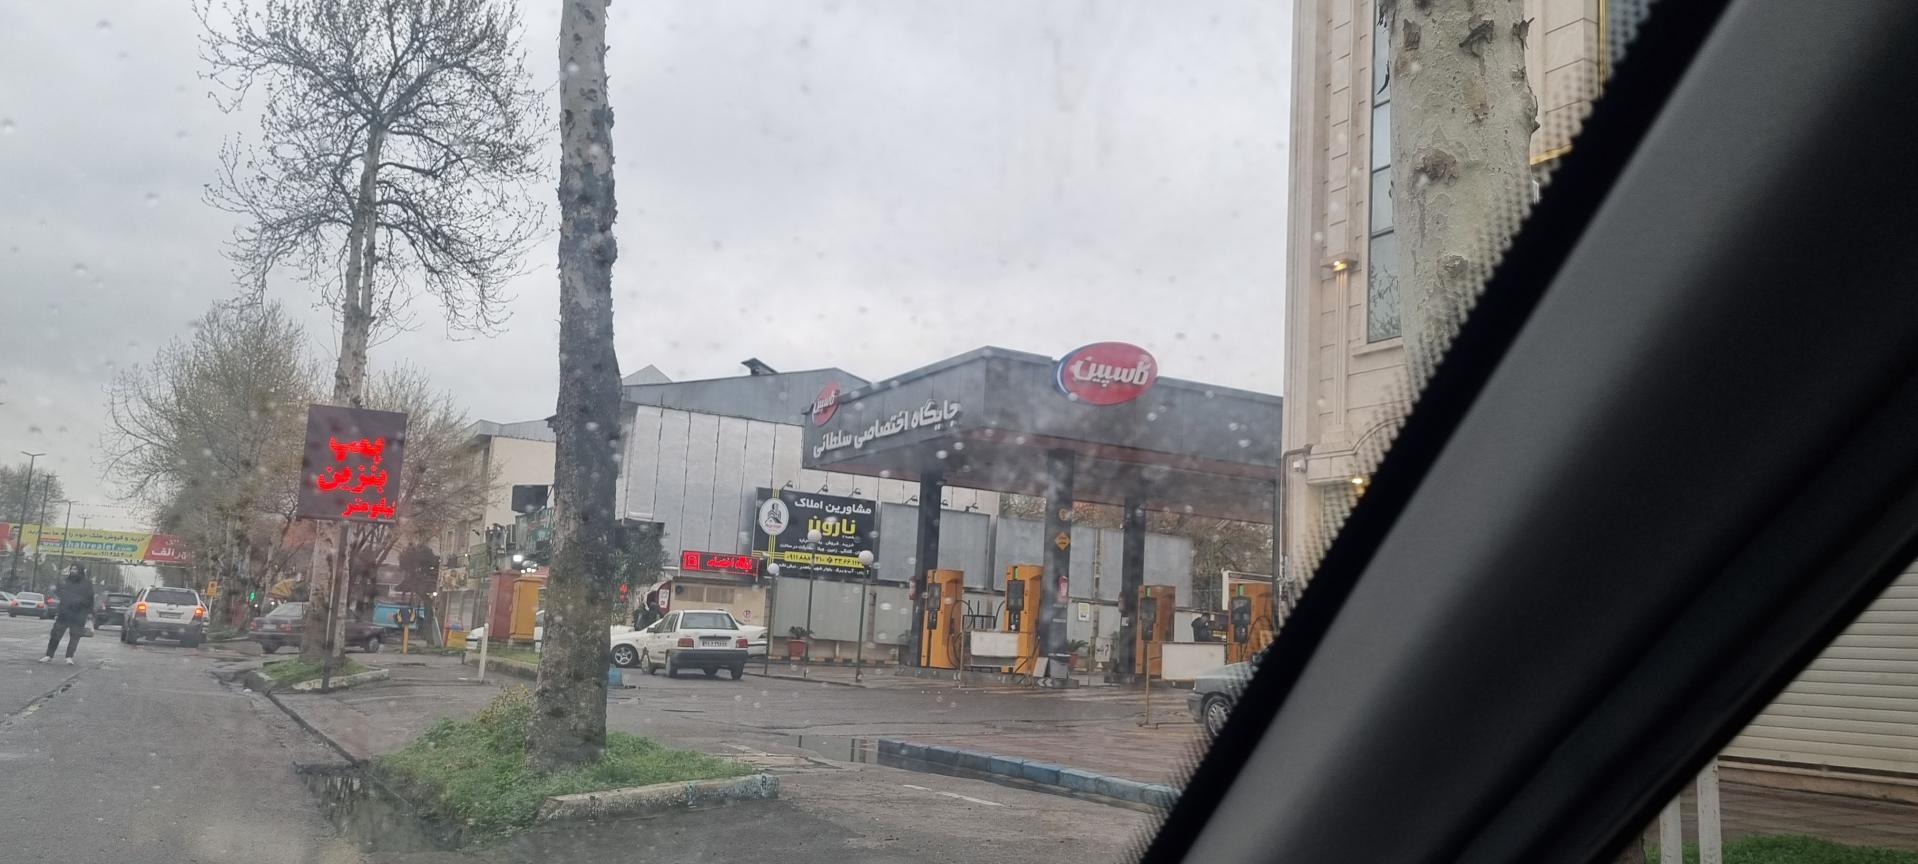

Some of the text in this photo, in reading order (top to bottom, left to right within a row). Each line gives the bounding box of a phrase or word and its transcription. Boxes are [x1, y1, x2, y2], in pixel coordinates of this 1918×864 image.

[1072, 354, 1152, 388] کاسپین
[813, 399, 961, 458] جایگاه اختصاصی سلطانی
[329, 435, 384, 464] پمپ
[316, 465, 388, 494] بنزین
[795, 498, 872, 515] مشاورین املاک
[151, 547, 175, 557] الف
